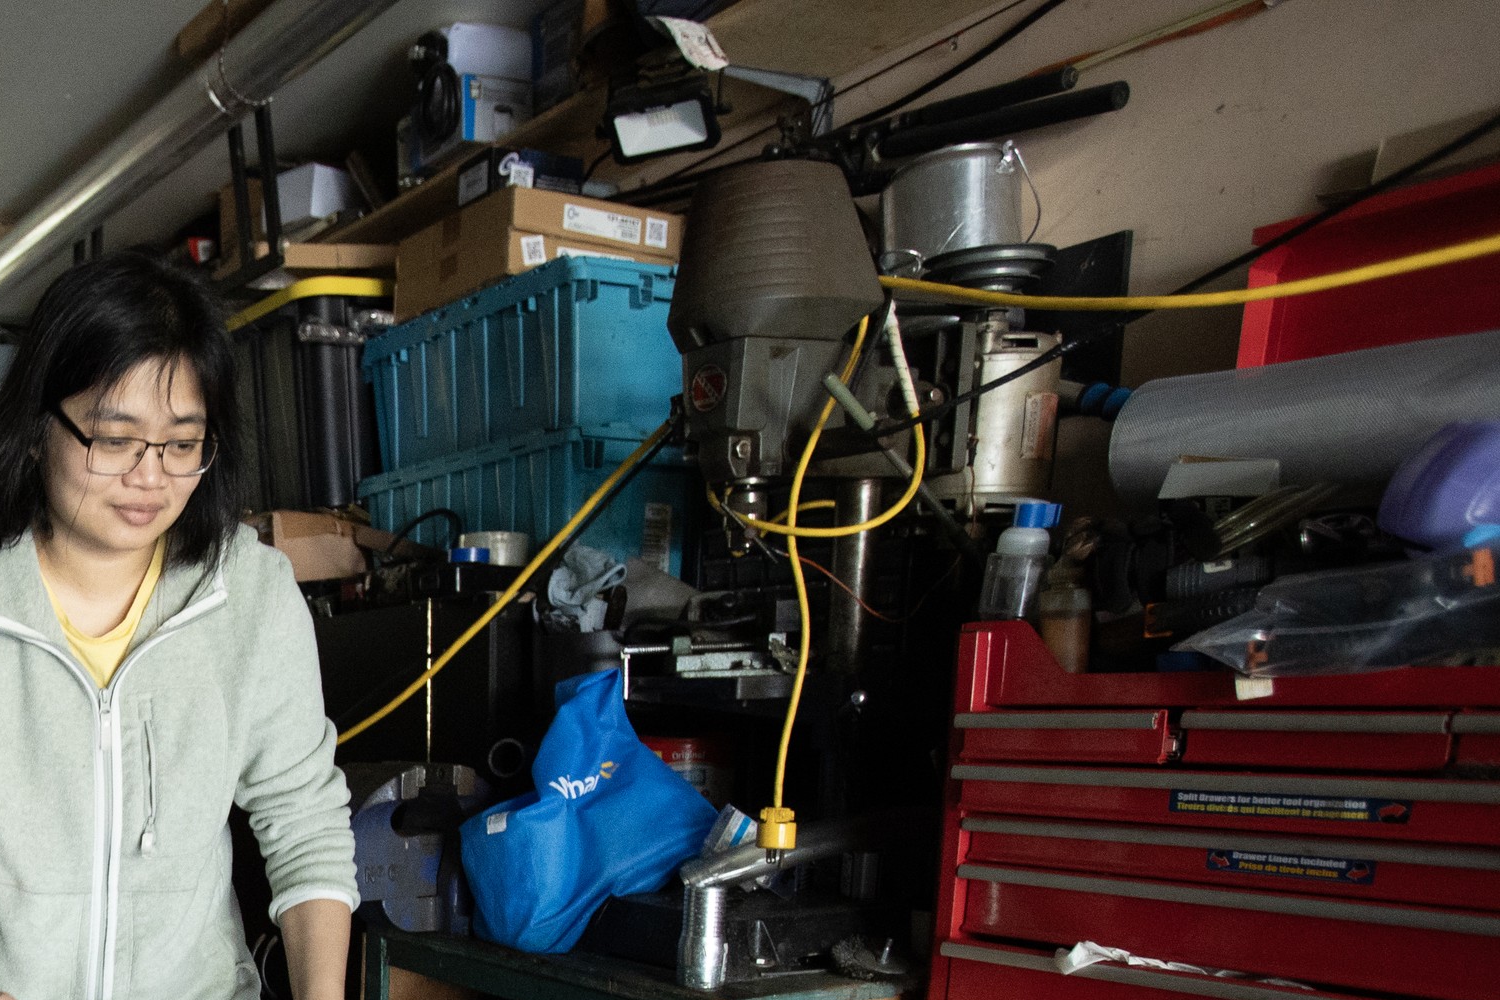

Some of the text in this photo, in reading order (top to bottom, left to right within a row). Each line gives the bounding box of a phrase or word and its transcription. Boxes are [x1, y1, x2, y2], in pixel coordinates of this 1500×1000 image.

[1177, 792, 1198, 802] Split
[1199, 794, 1236, 803] Drawers
[1237, 795, 1251, 804] for
[1252, 796, 1281, 805] better
[1282, 798, 1302, 806] tool
[1177, 801, 1205, 811] Tiroirs
[1232, 851, 1347, 868] Drawer Liners Included
[1264, 864, 1278, 872] de
